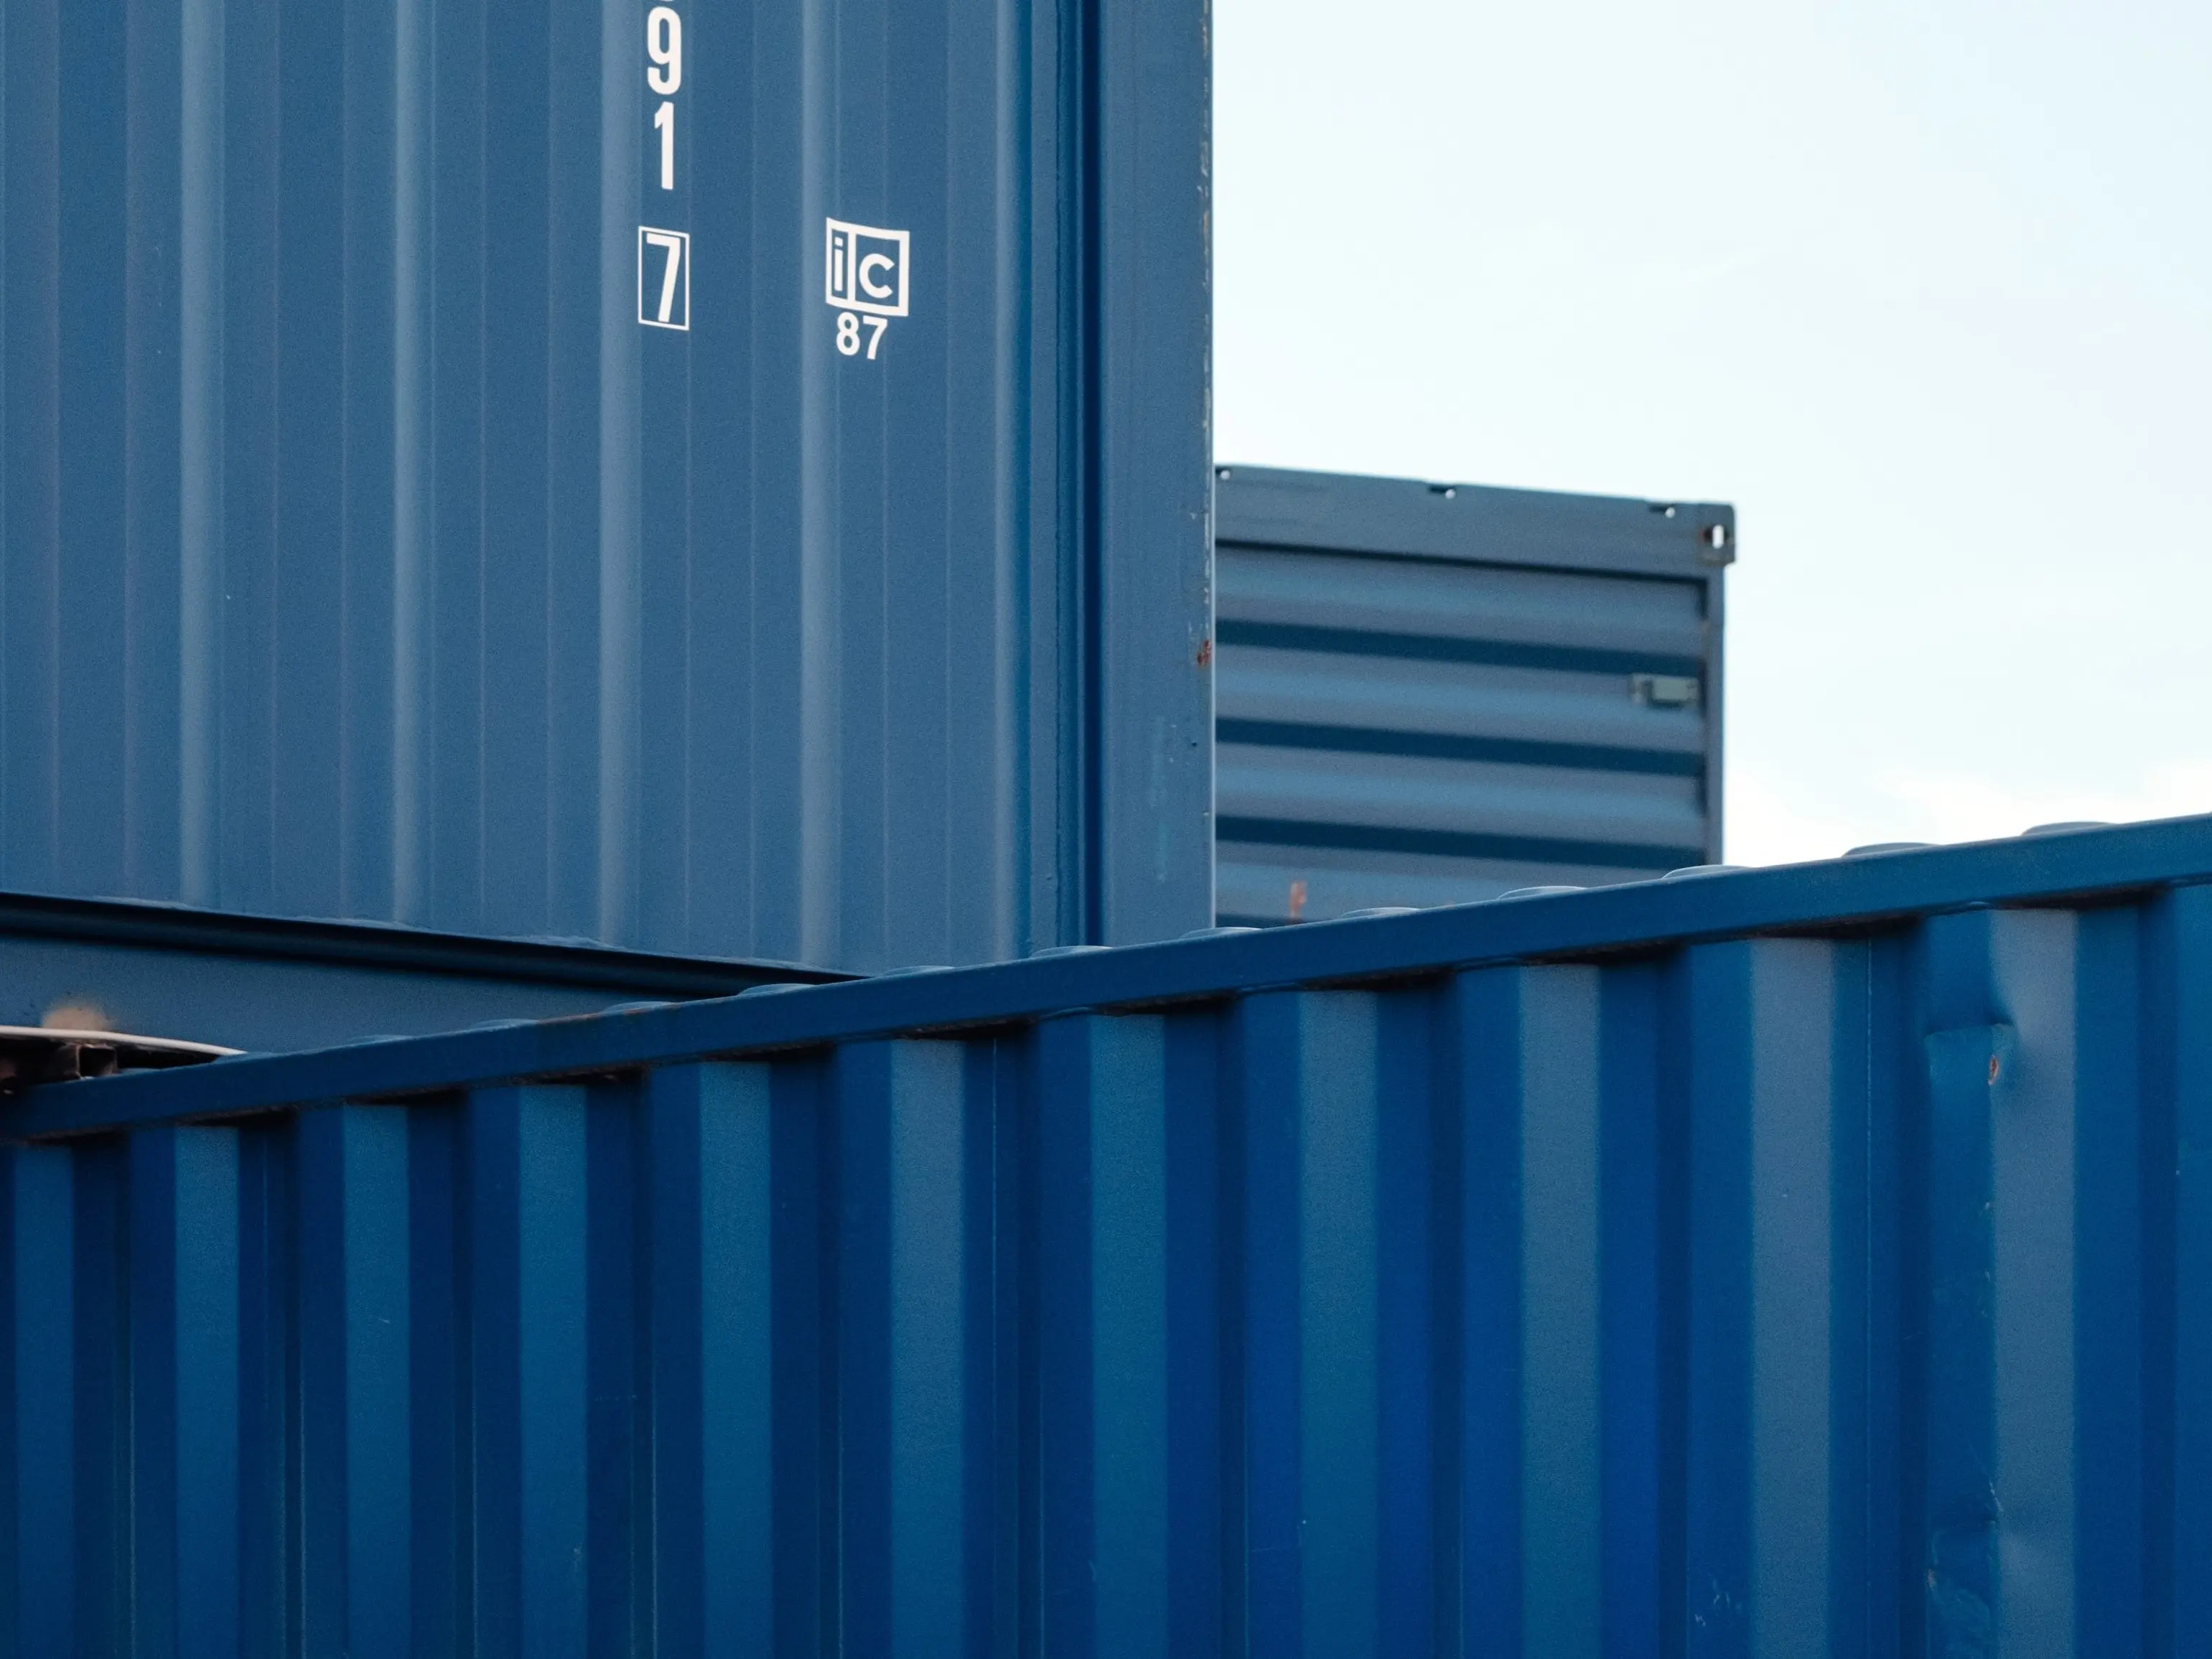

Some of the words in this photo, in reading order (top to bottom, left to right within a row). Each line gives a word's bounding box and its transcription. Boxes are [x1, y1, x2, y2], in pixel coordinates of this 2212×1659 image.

[647, 0, 682, 190] 91
[646, 232, 681, 323] 7
[836, 312, 888, 360] 87
